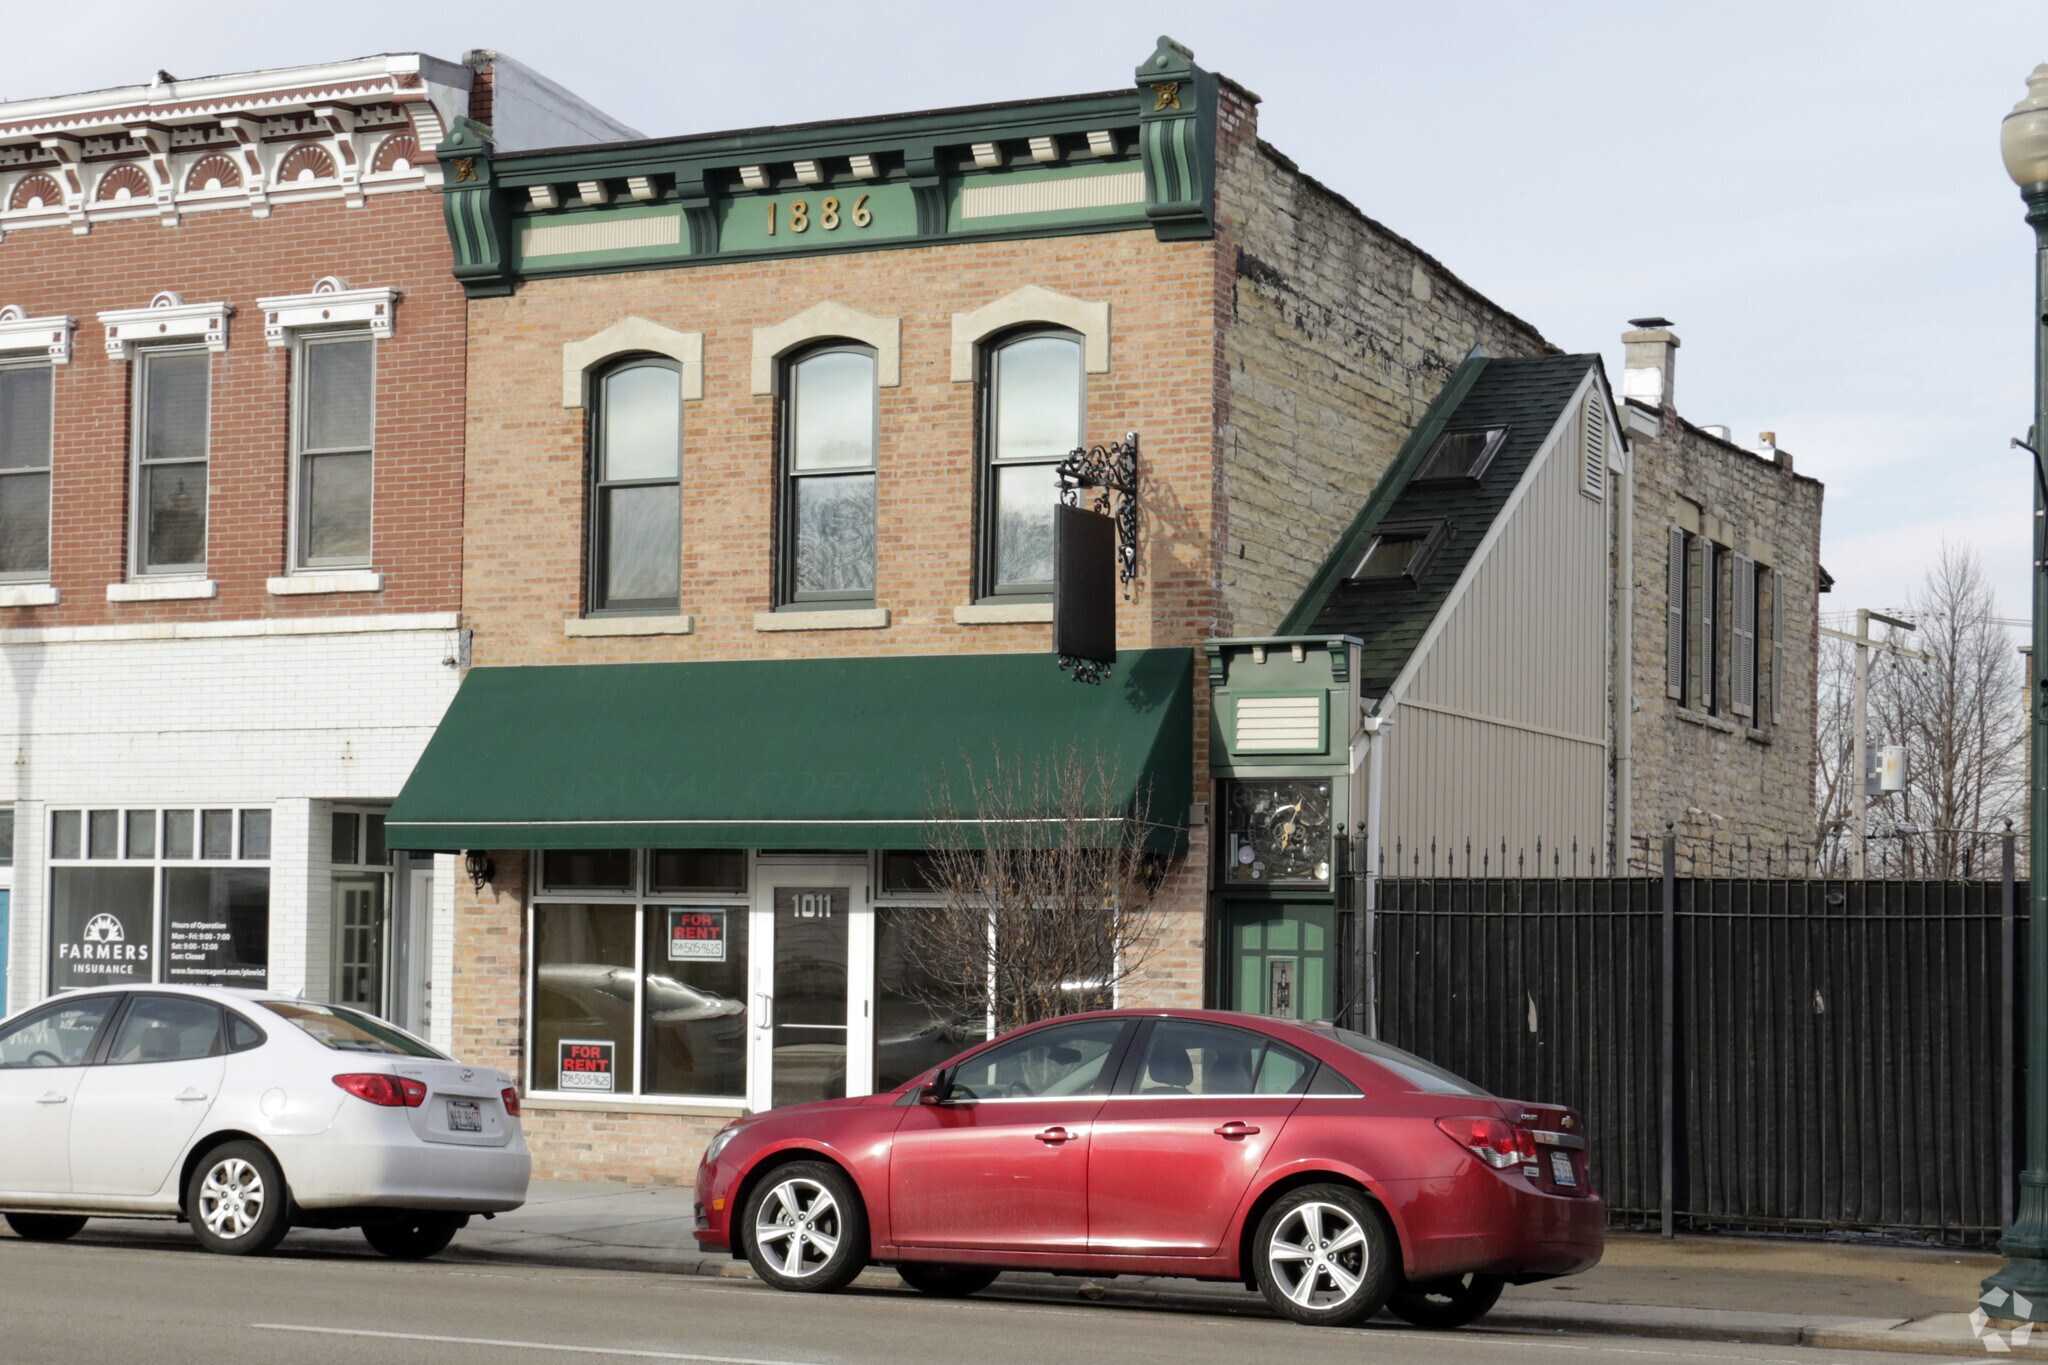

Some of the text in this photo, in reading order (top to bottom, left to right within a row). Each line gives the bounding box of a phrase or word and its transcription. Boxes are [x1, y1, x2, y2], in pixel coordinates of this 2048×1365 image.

[767, 193, 871, 236] 1886
[792, 894, 831, 918] 1011
[171, 921, 227, 930] Hours of Operation
[681, 914, 712, 926] FOR
[171, 932, 184, 940] Mon
[217, 933, 231, 941] 7:00
[673, 926, 720, 940] RENT
[59, 944, 149, 961] FARMERS
[201, 943, 218, 951] 12:00
[185, 953, 206, 961] Closed
[73, 963, 133, 975] INSURANCE
[571, 1046, 601, 1059] FOR
[563, 1059, 608, 1072] RENT
